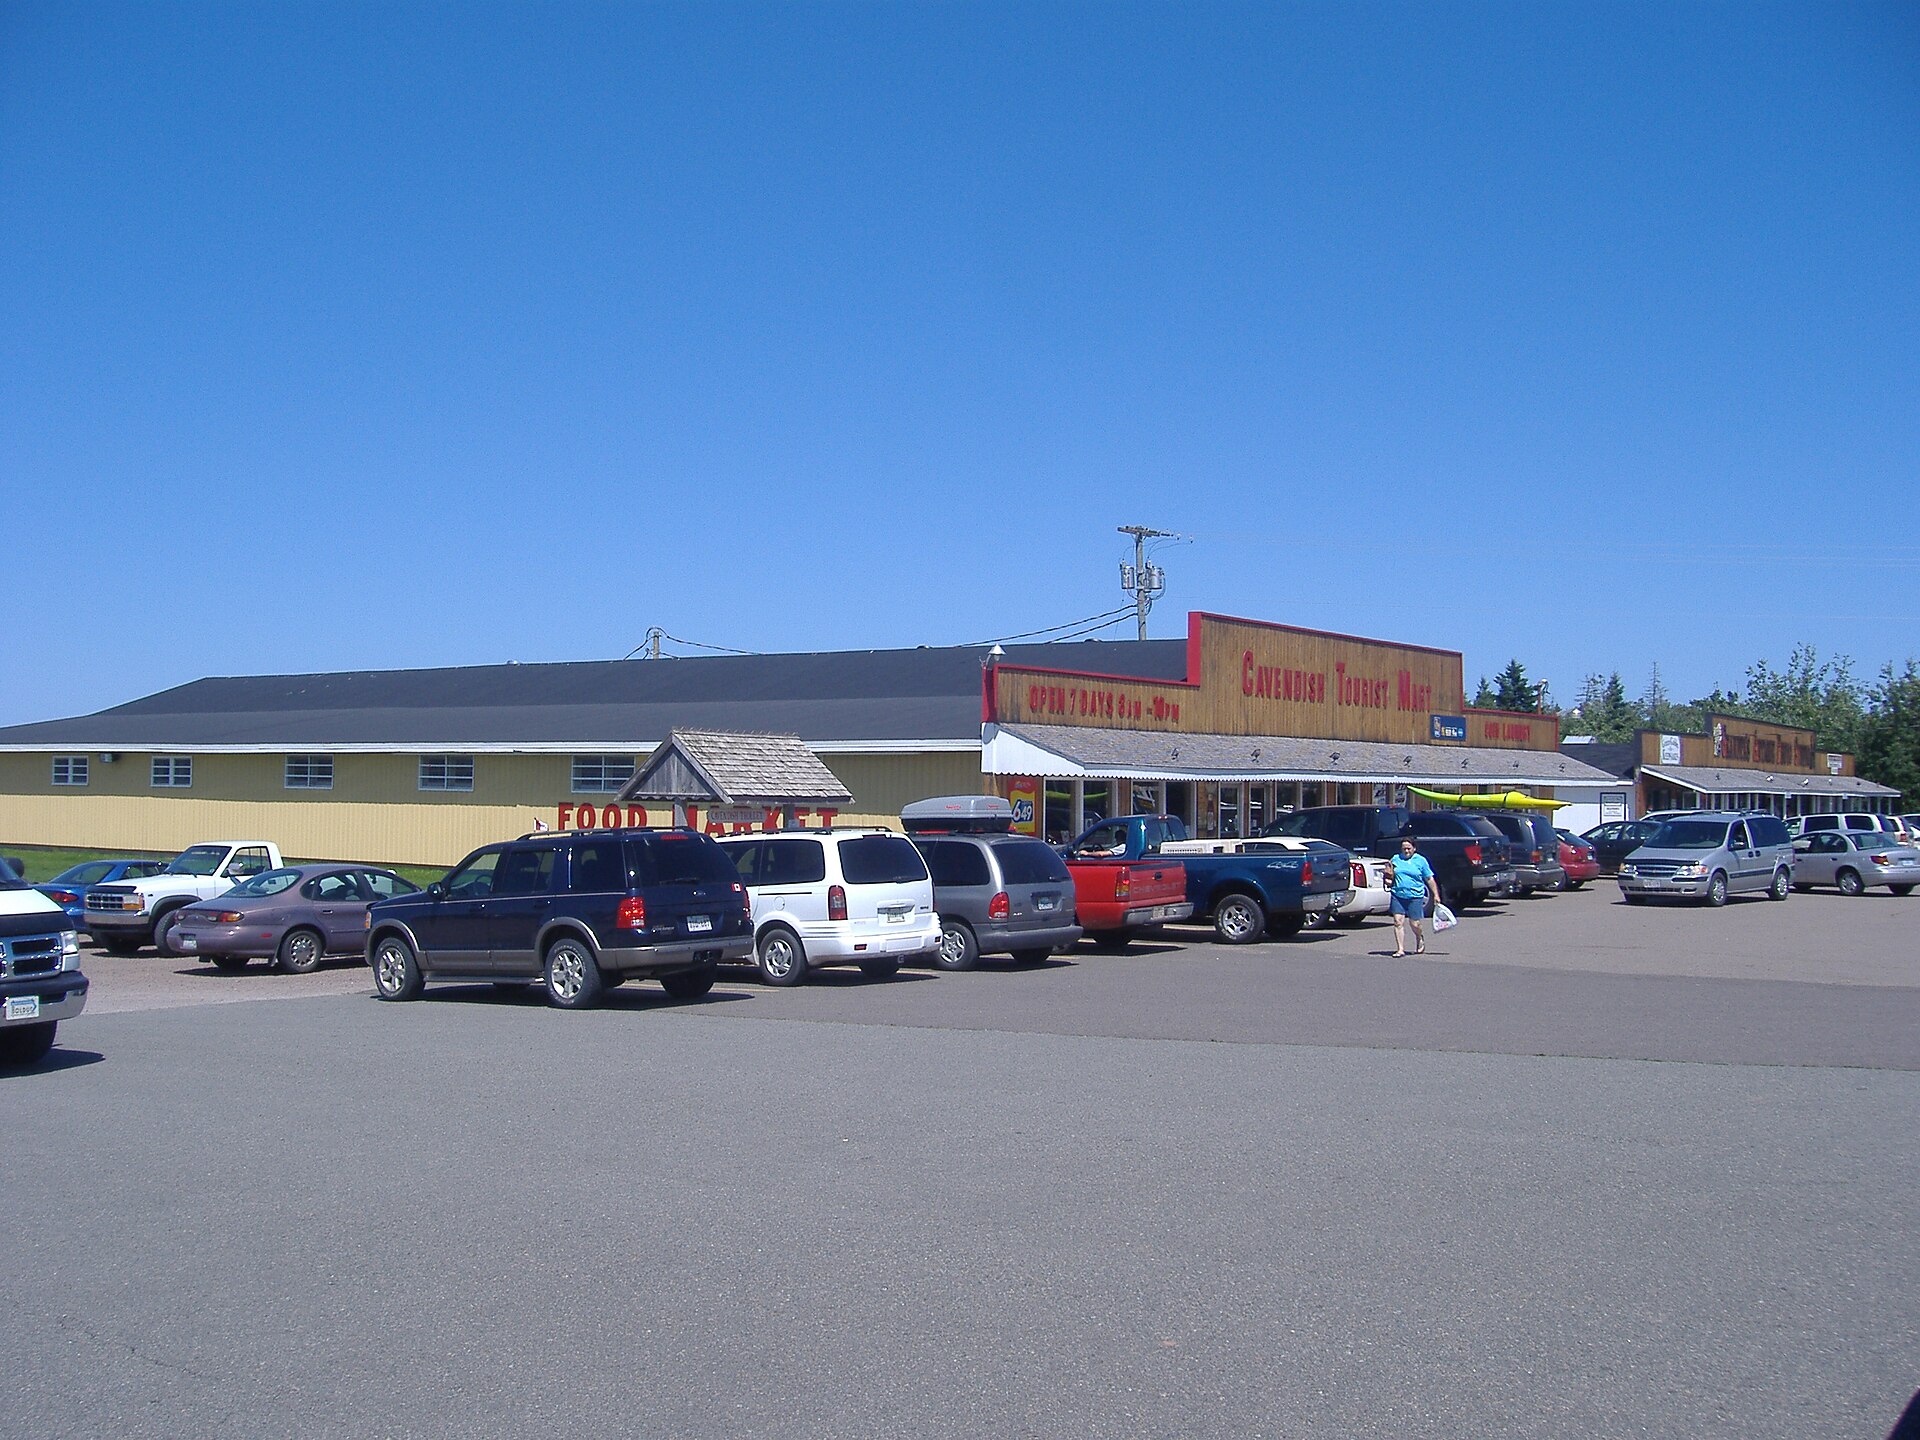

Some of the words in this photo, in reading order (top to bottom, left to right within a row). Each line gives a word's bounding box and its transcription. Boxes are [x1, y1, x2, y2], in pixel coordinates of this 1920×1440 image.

[1242, 650, 1325, 703] CAVENDISH
[1335, 662, 1389, 709] TOURIST
[1397, 670, 1432, 713] MART
[1029, 686, 1065, 716] OPEN
[1080, 689, 1114, 719] DAYS
[558, 802, 648, 831] FOOD
